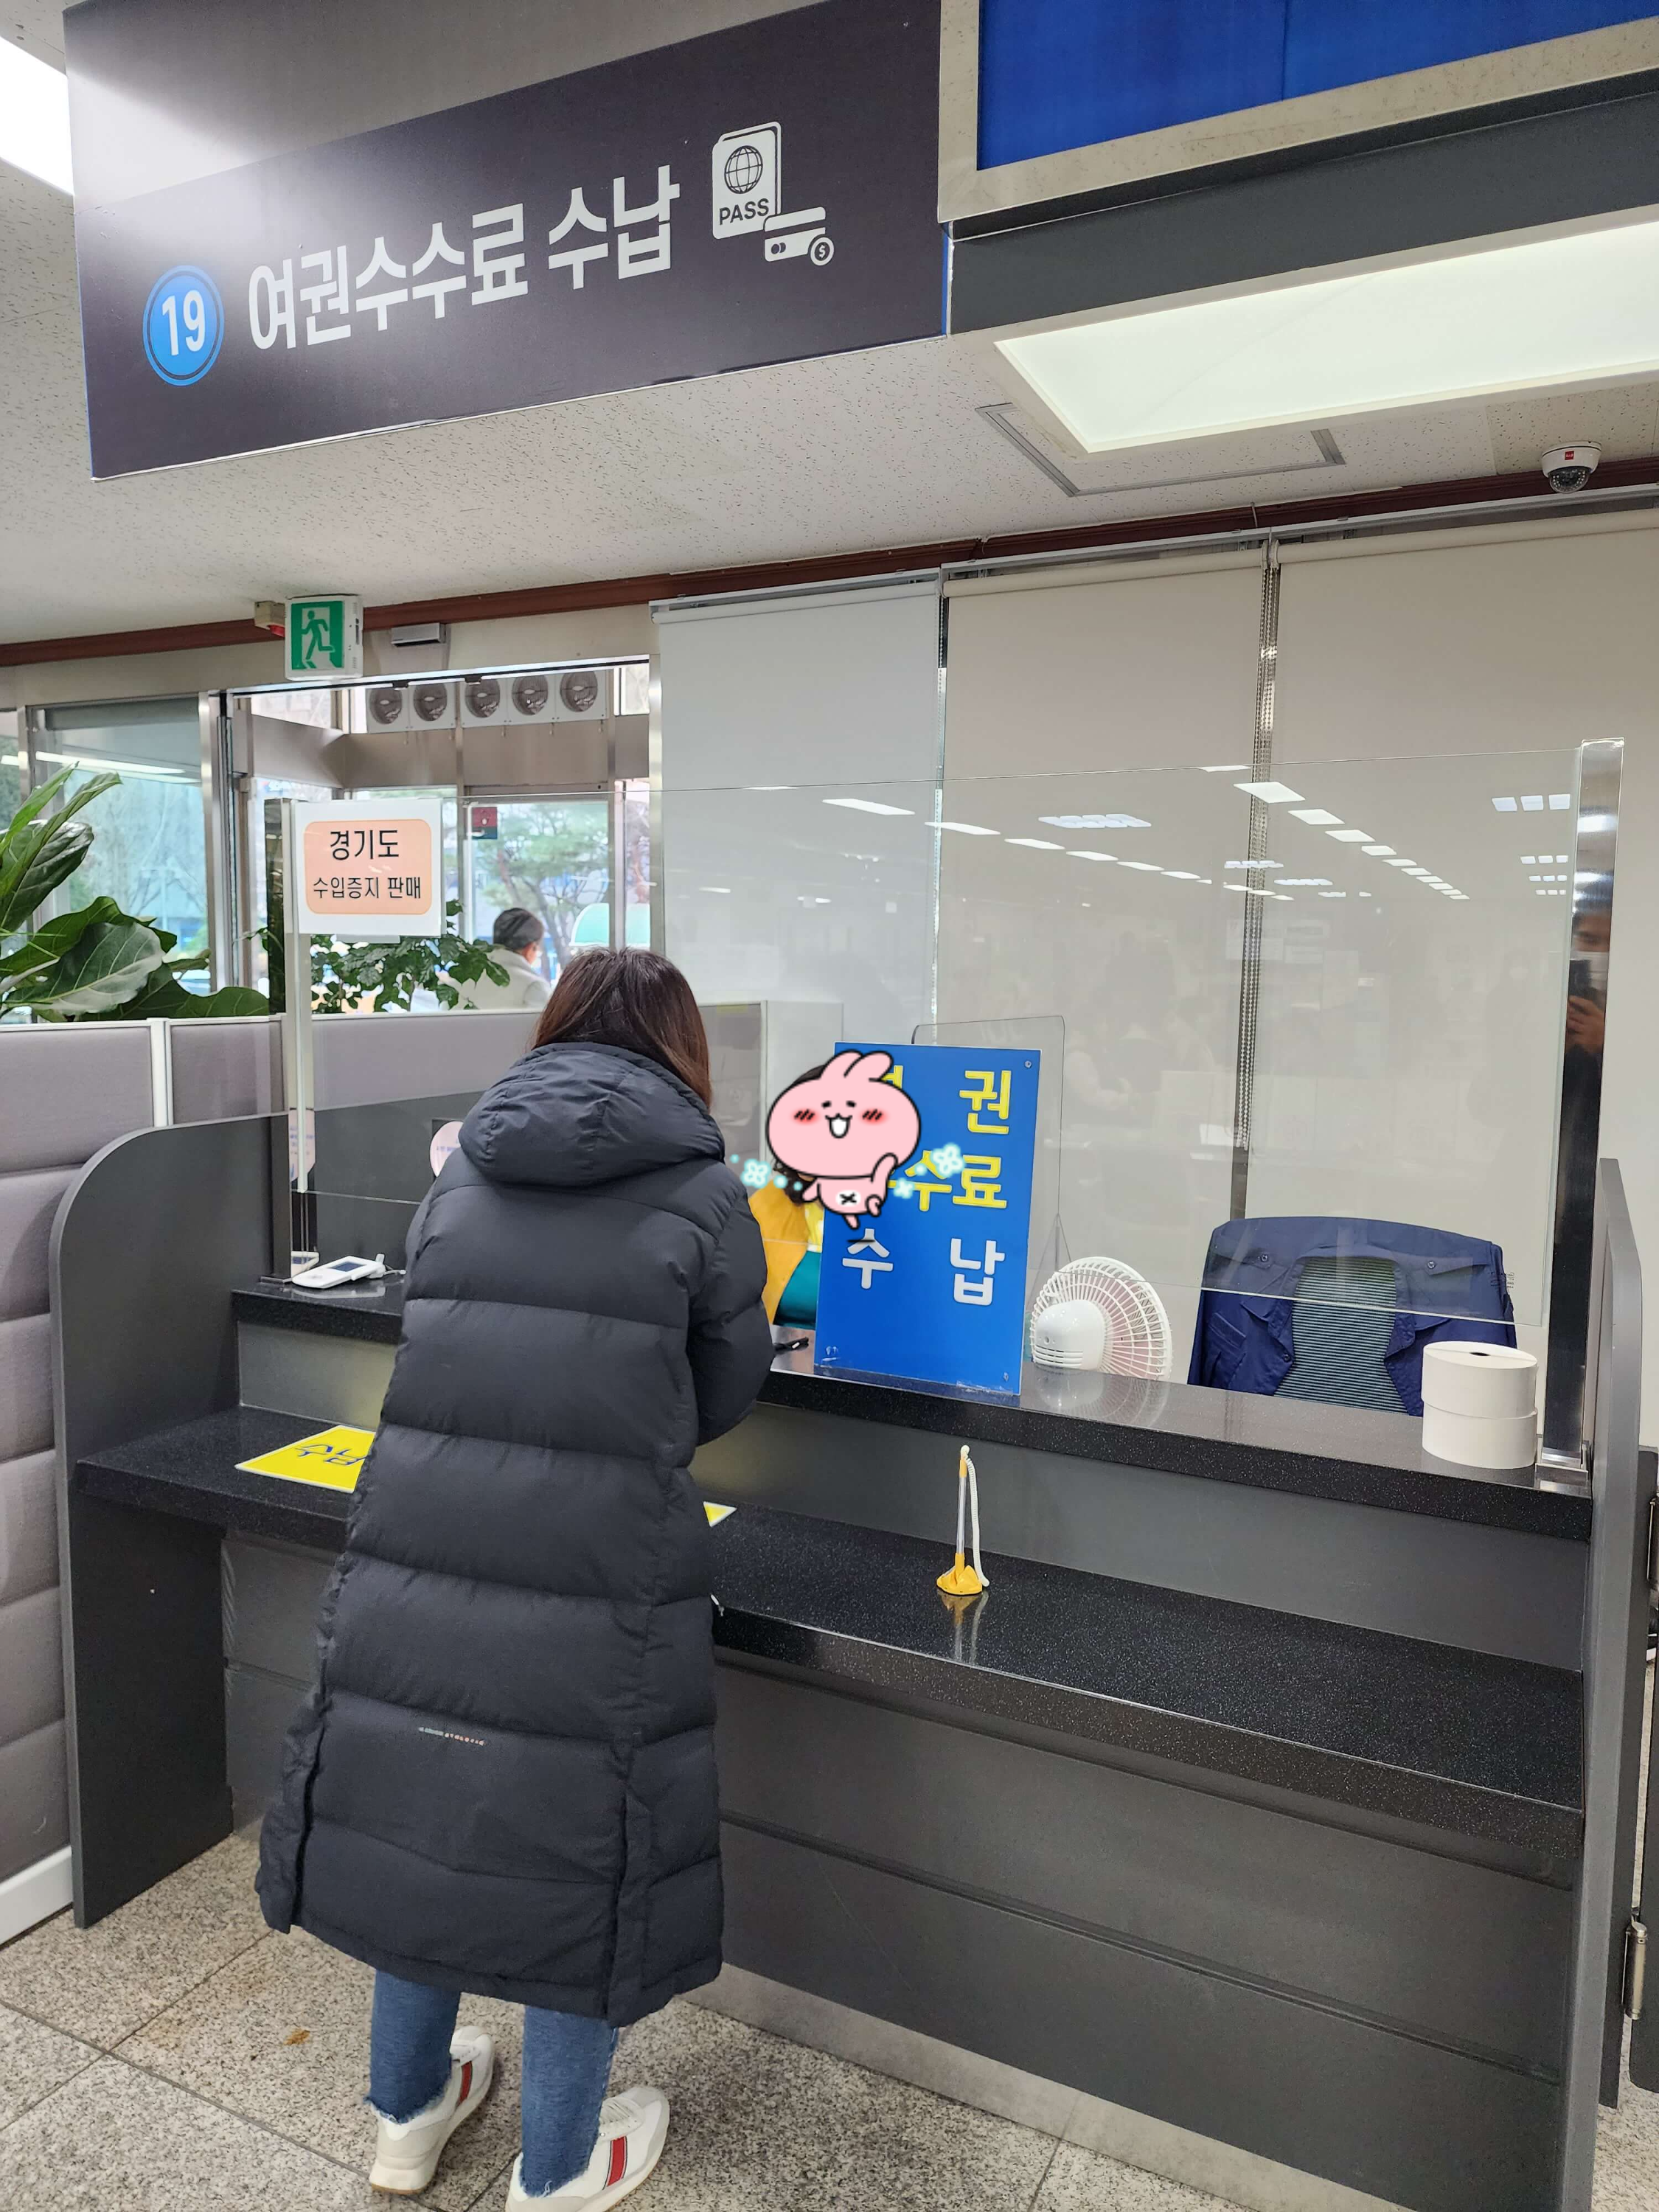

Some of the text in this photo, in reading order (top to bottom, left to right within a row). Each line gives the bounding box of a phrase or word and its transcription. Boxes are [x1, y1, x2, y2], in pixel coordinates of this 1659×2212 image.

[719, 198, 770, 226] PASS
[160, 164, 681, 357] 19 여권수수료 수납
[330, 830, 400, 860] 경기도
[313, 876, 422, 900] 수입증지 판매
